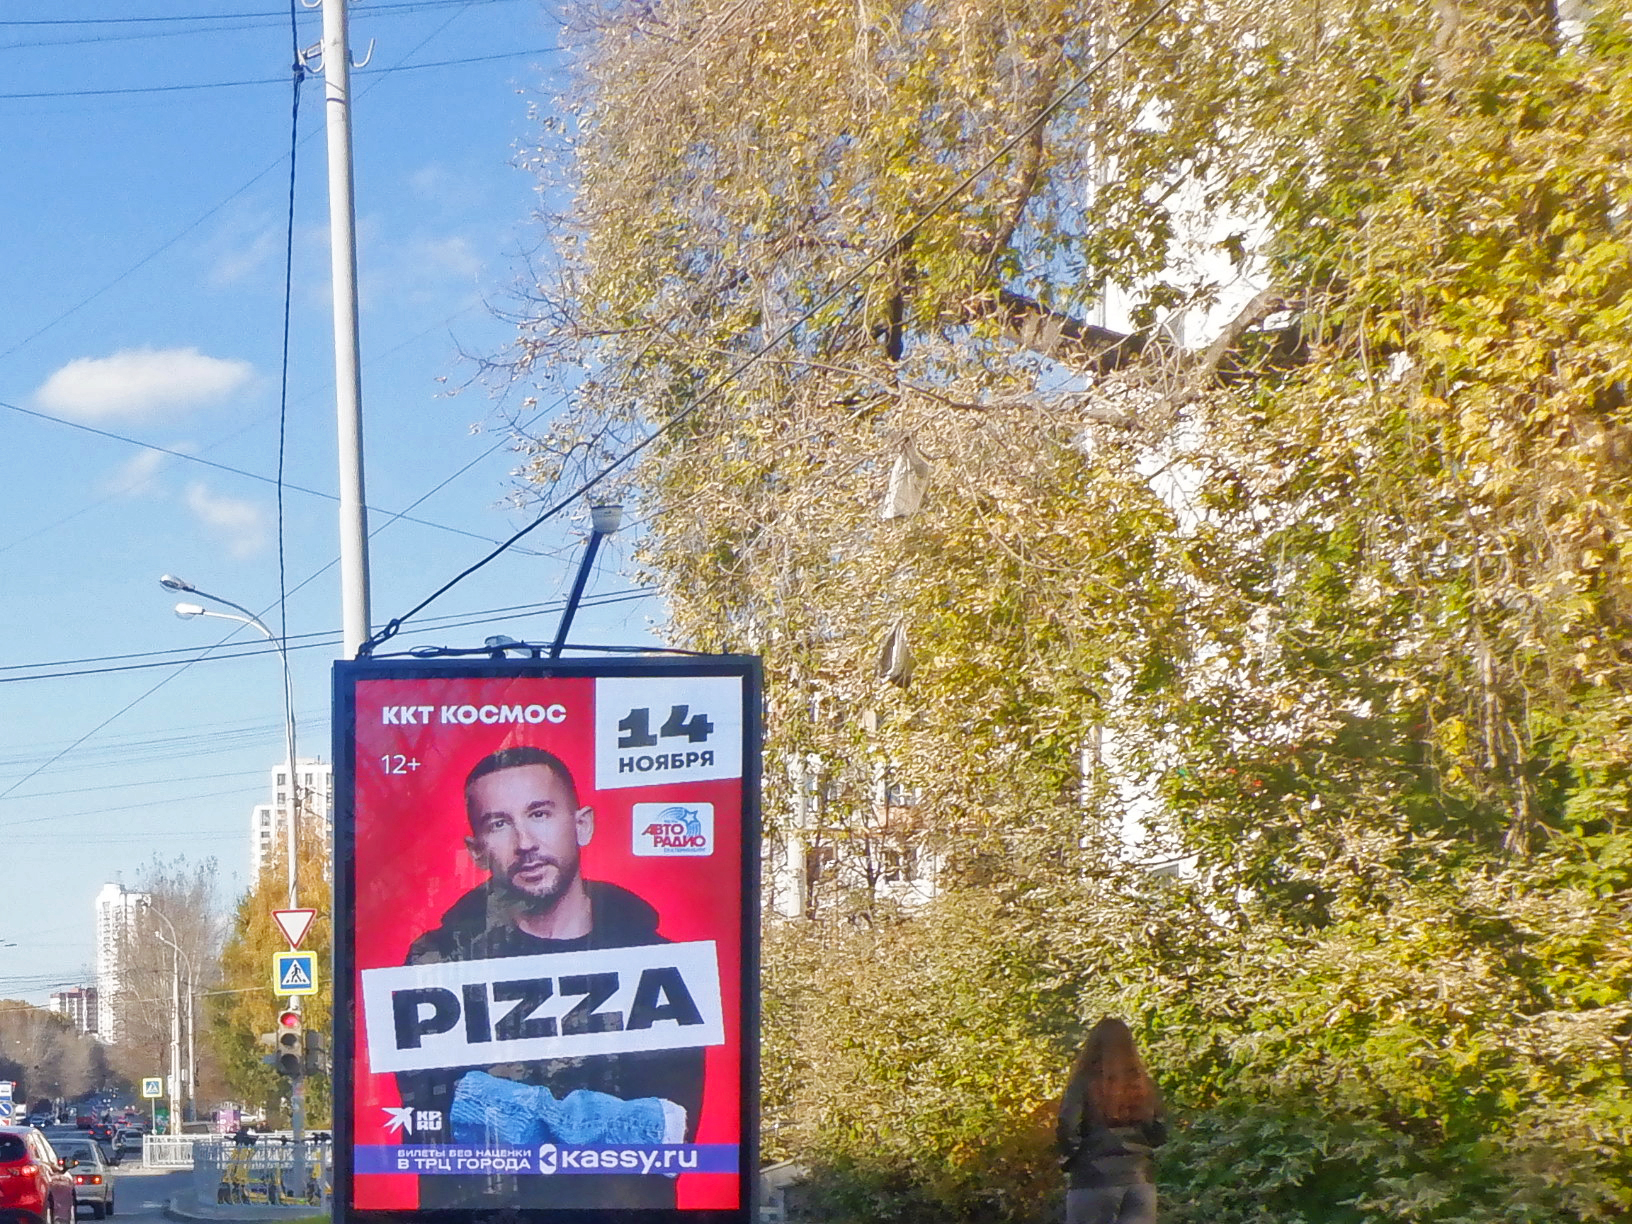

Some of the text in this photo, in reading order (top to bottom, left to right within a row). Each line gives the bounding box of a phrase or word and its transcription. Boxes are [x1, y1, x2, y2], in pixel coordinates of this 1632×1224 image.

[382, 704, 567, 725] ККТ КОСМОС
[617, 704, 714, 749] 14
[381, 754, 421, 775] 12+
[618, 750, 714, 773] НОЯБРЯ
[641, 823, 685, 836] АВТО
[653, 834, 706, 848] РАДИО
[391, 966, 705, 1050] PIZZA
[397, 1149, 446, 1158] БИЛЕТЫ
[475, 1149, 532, 1159] НАЦЕНКИ
[397, 1158, 531, 1171] В ТРЦ ГОРОДА
[561, 1149, 697, 1175] kassy.ru
